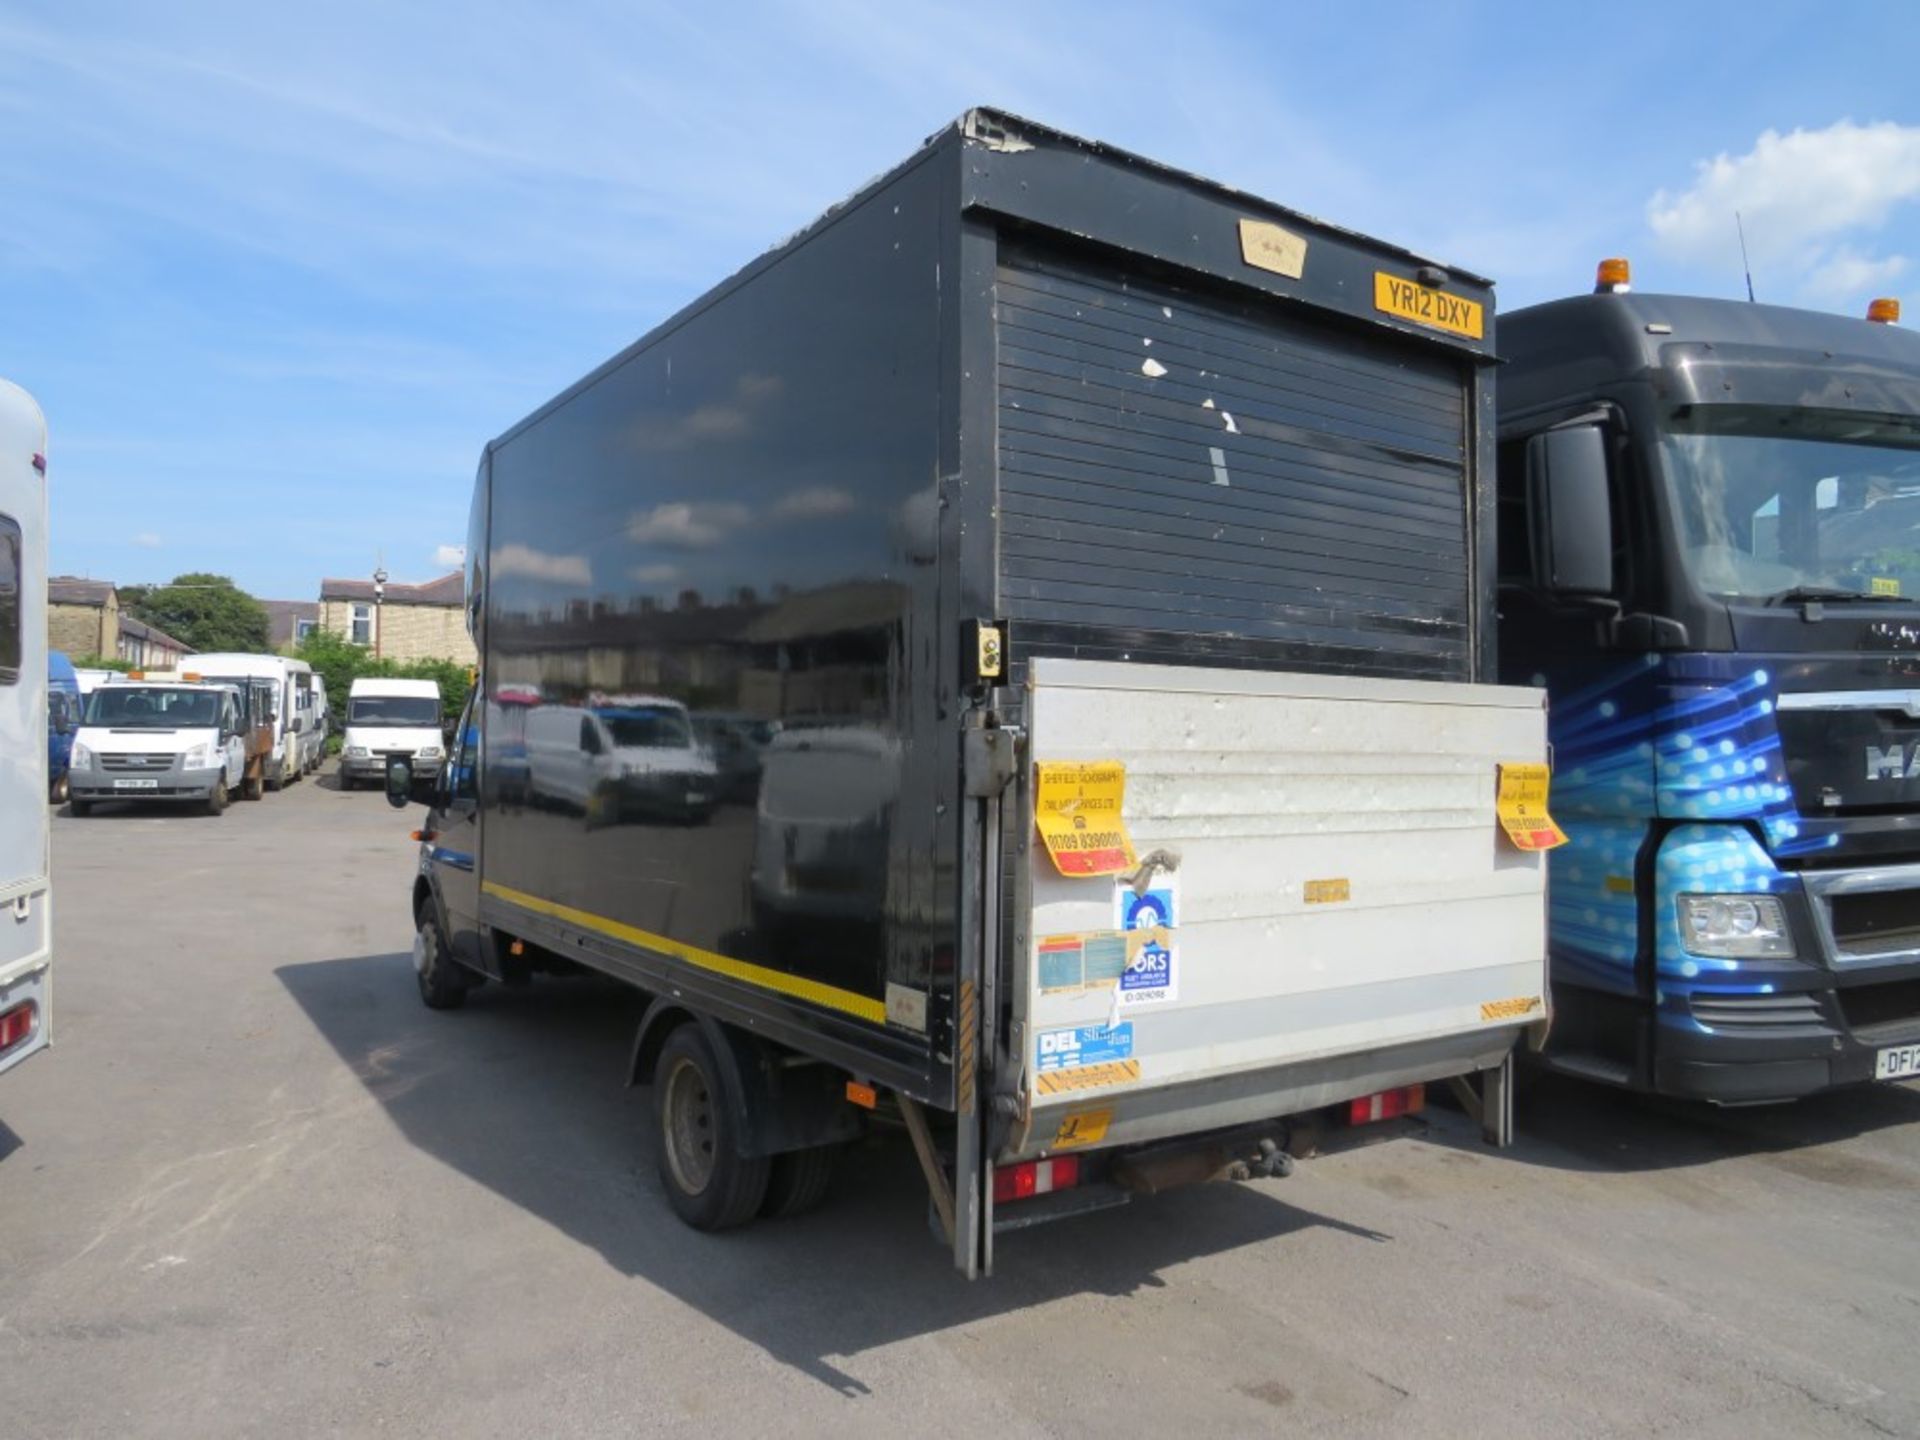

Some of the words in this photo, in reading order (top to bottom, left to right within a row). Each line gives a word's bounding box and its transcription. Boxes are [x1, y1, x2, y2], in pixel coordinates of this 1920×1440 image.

[1389, 279, 1431, 317] YR12
[1436, 294, 1471, 329] DXY
[1134, 953, 1167, 974] ORS
[1040, 1030, 1082, 1054] DEL
